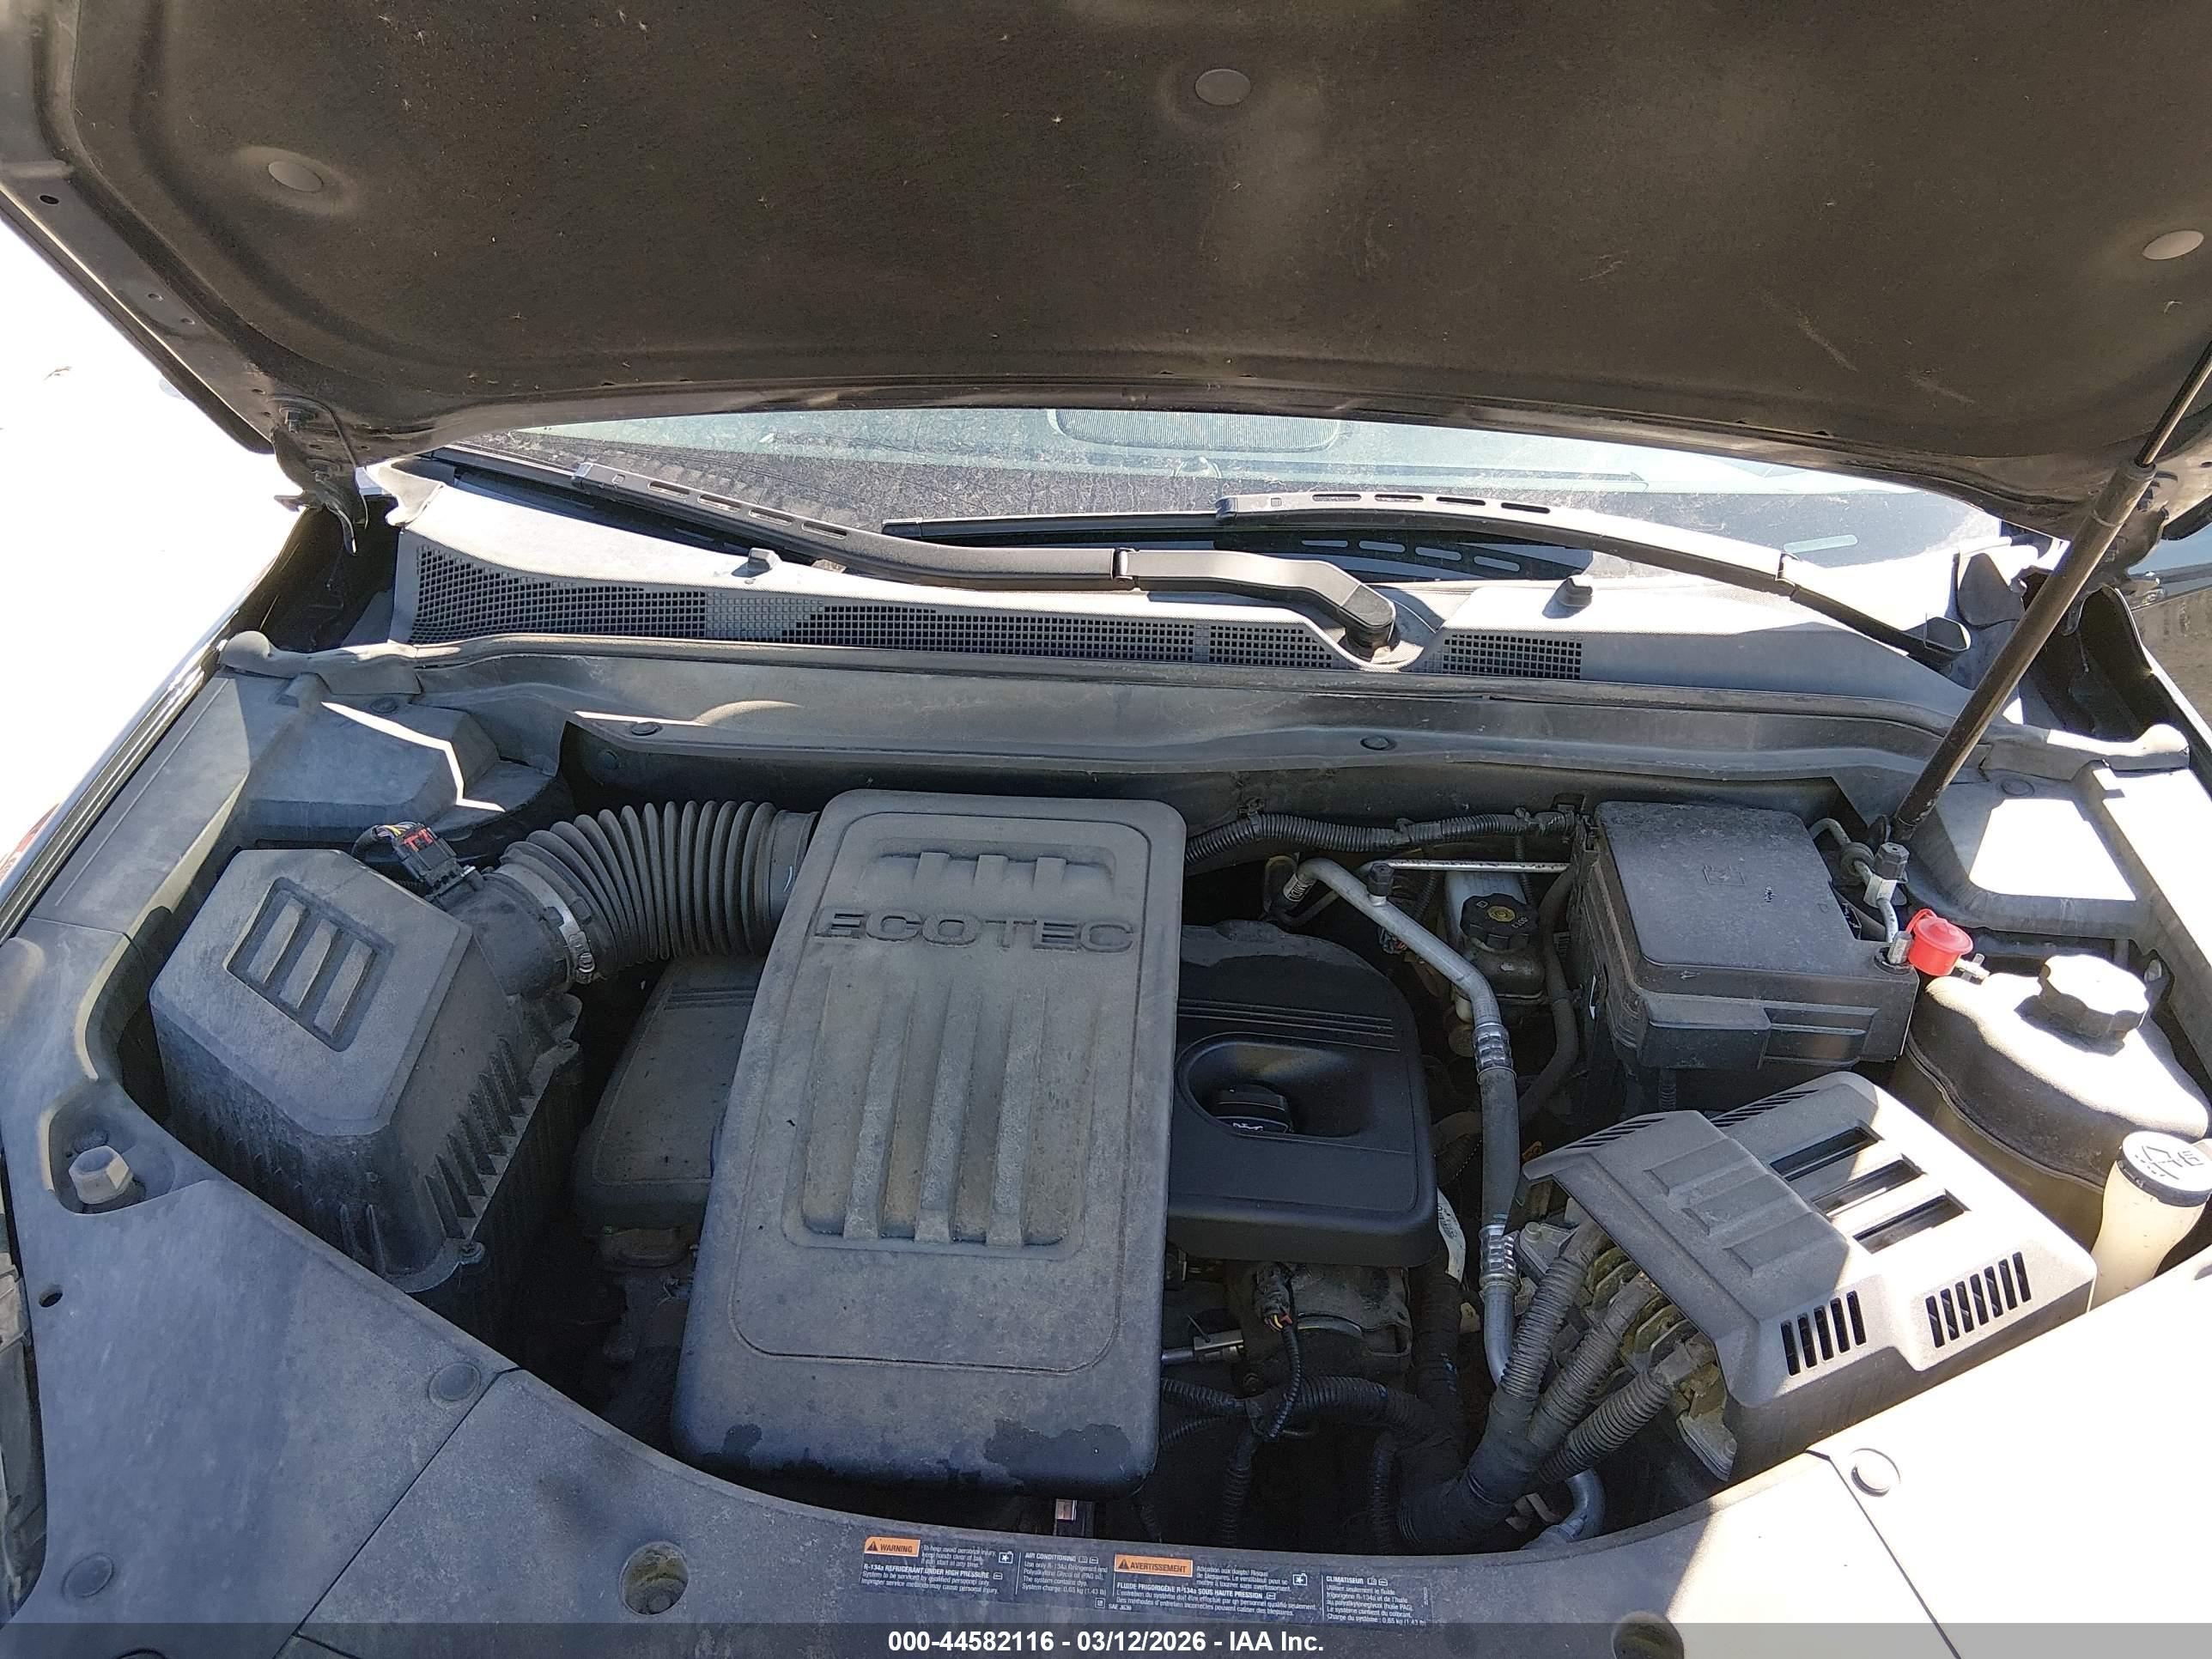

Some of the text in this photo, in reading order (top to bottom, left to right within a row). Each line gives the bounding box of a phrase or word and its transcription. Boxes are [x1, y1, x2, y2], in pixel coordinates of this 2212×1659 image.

[814, 907, 1135, 954] ECOTEC
[880, 1544, 912, 1553] WARNING
[1036, 1553, 1076, 1561] CONDITIONING
[1130, 1562, 1187, 1573] AVERTISSEMENT
[960, 1570, 989, 1578] PRESSURE
[1326, 1576, 1364, 1584] CLIMATISEUR
